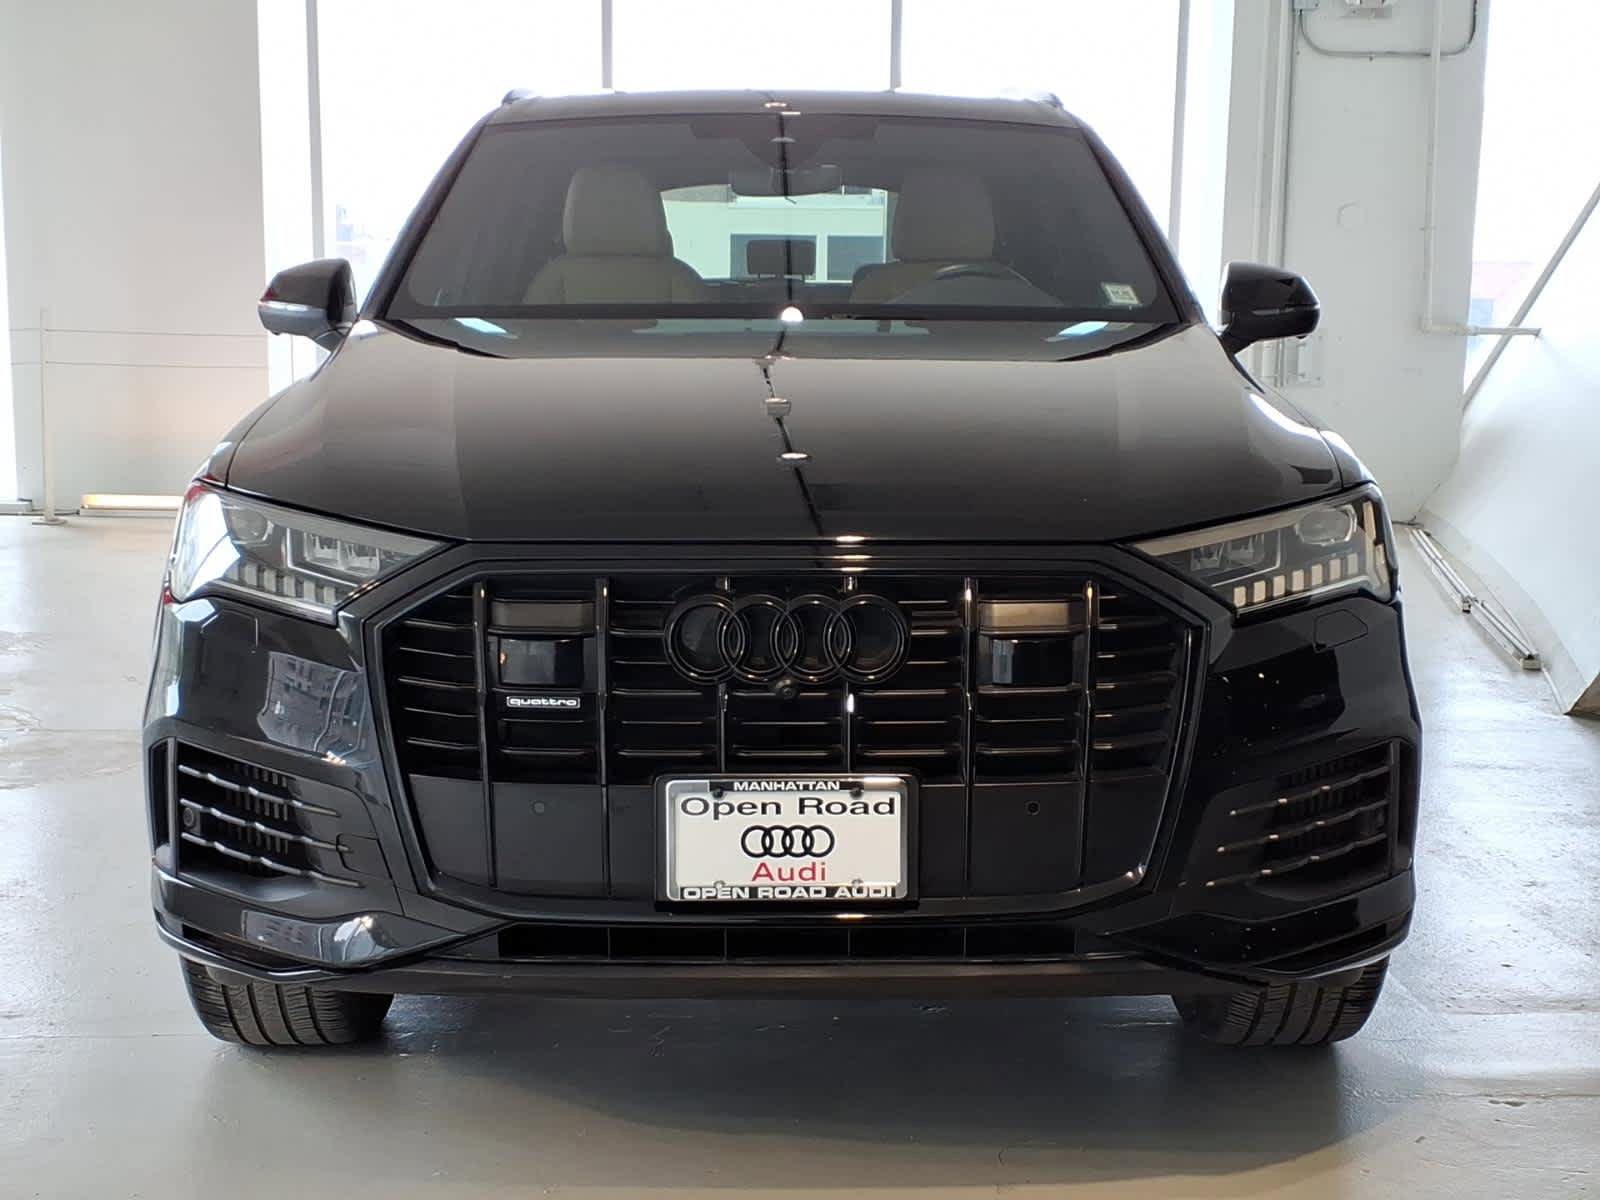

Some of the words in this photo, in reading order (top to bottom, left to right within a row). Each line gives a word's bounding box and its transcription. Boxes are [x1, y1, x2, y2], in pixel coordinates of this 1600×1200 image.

[509, 698, 577, 706] quattro
[733, 781, 840, 791] MANHATTAN
[681, 797, 782, 820] Open
[799, 797, 895, 816] Road
[751, 862, 826, 882] Audi
[683, 886, 750, 899] OPEN
[757, 886, 827, 899] ROAD
[834, 886, 893, 898] AUDI
